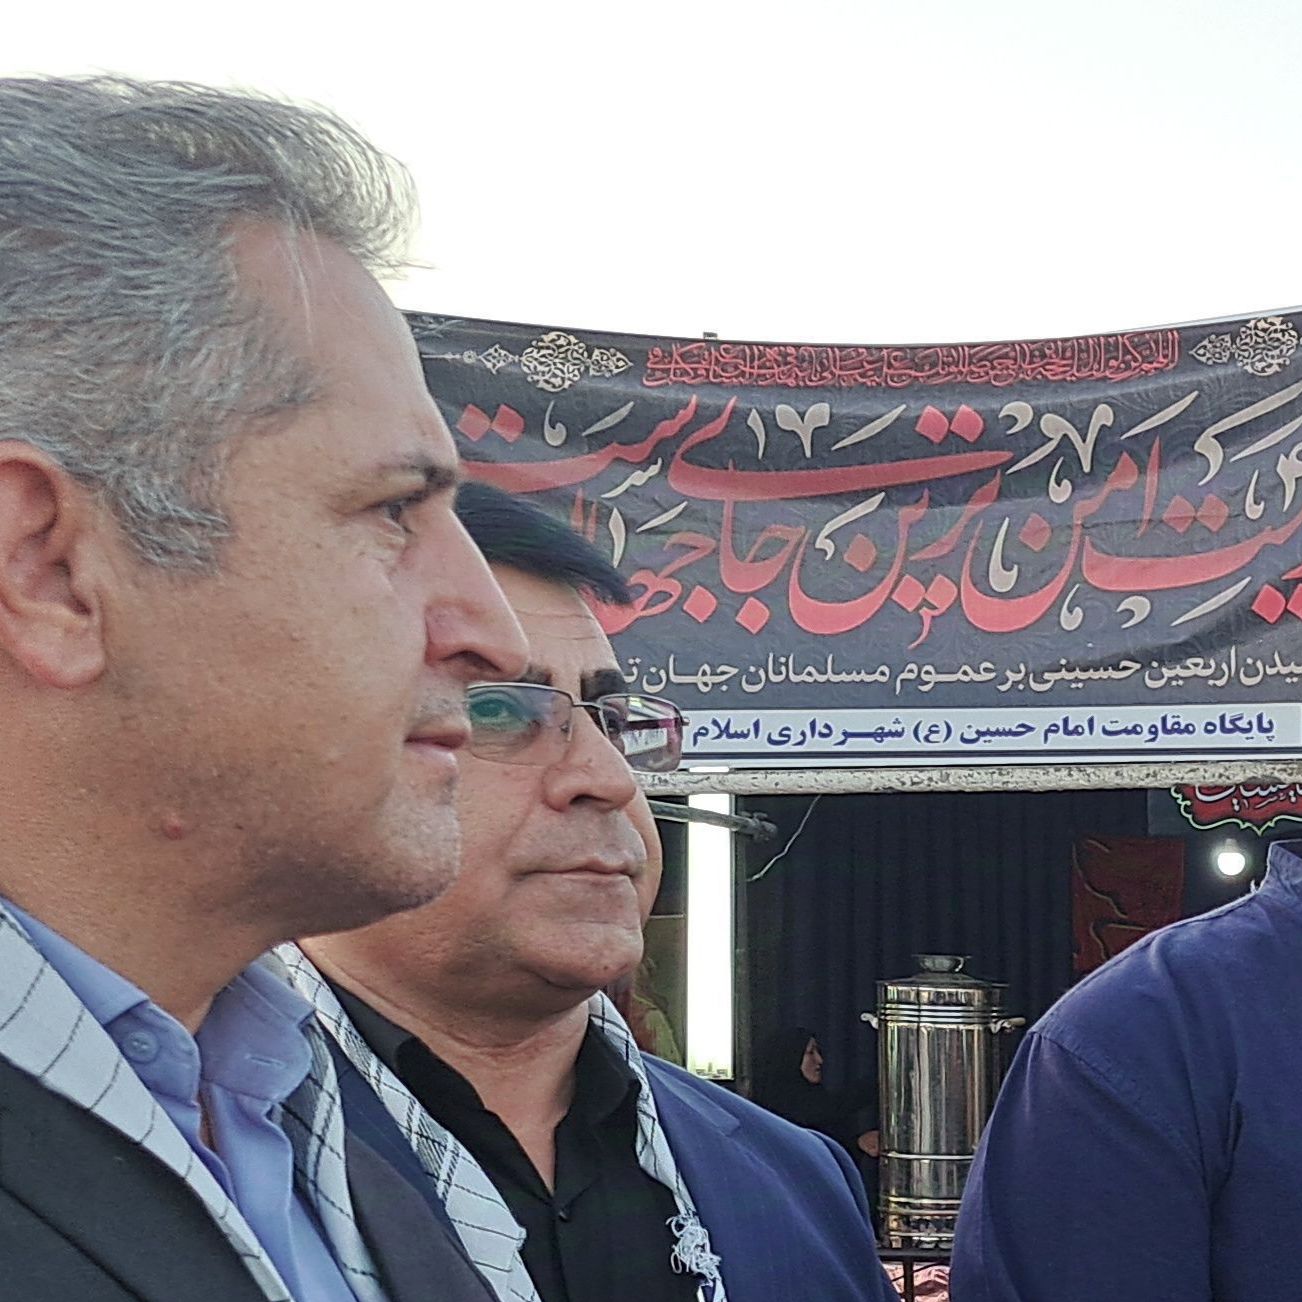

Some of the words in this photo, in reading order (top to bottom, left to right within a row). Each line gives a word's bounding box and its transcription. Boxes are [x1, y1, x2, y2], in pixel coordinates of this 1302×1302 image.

[641, 655, 740, 690] جهان
[742, 654, 889, 690] مسلمانان
[896, 657, 995, 695] عموم
[998, 658, 1026, 692] بر
[1030, 656, 1142, 692] حسینی
[1145, 645, 1237, 687] اربعین
[692, 717, 760, 745] اسلام
[767, 717, 905, 749] شهرداری
[912, 722, 953, 745] (ع)
[960, 722, 1034, 743] حسین
[1043, 717, 1095, 741] امام
[1101, 715, 1196, 740] مقاومت
[1203, 712, 1275, 741] پایگاه
